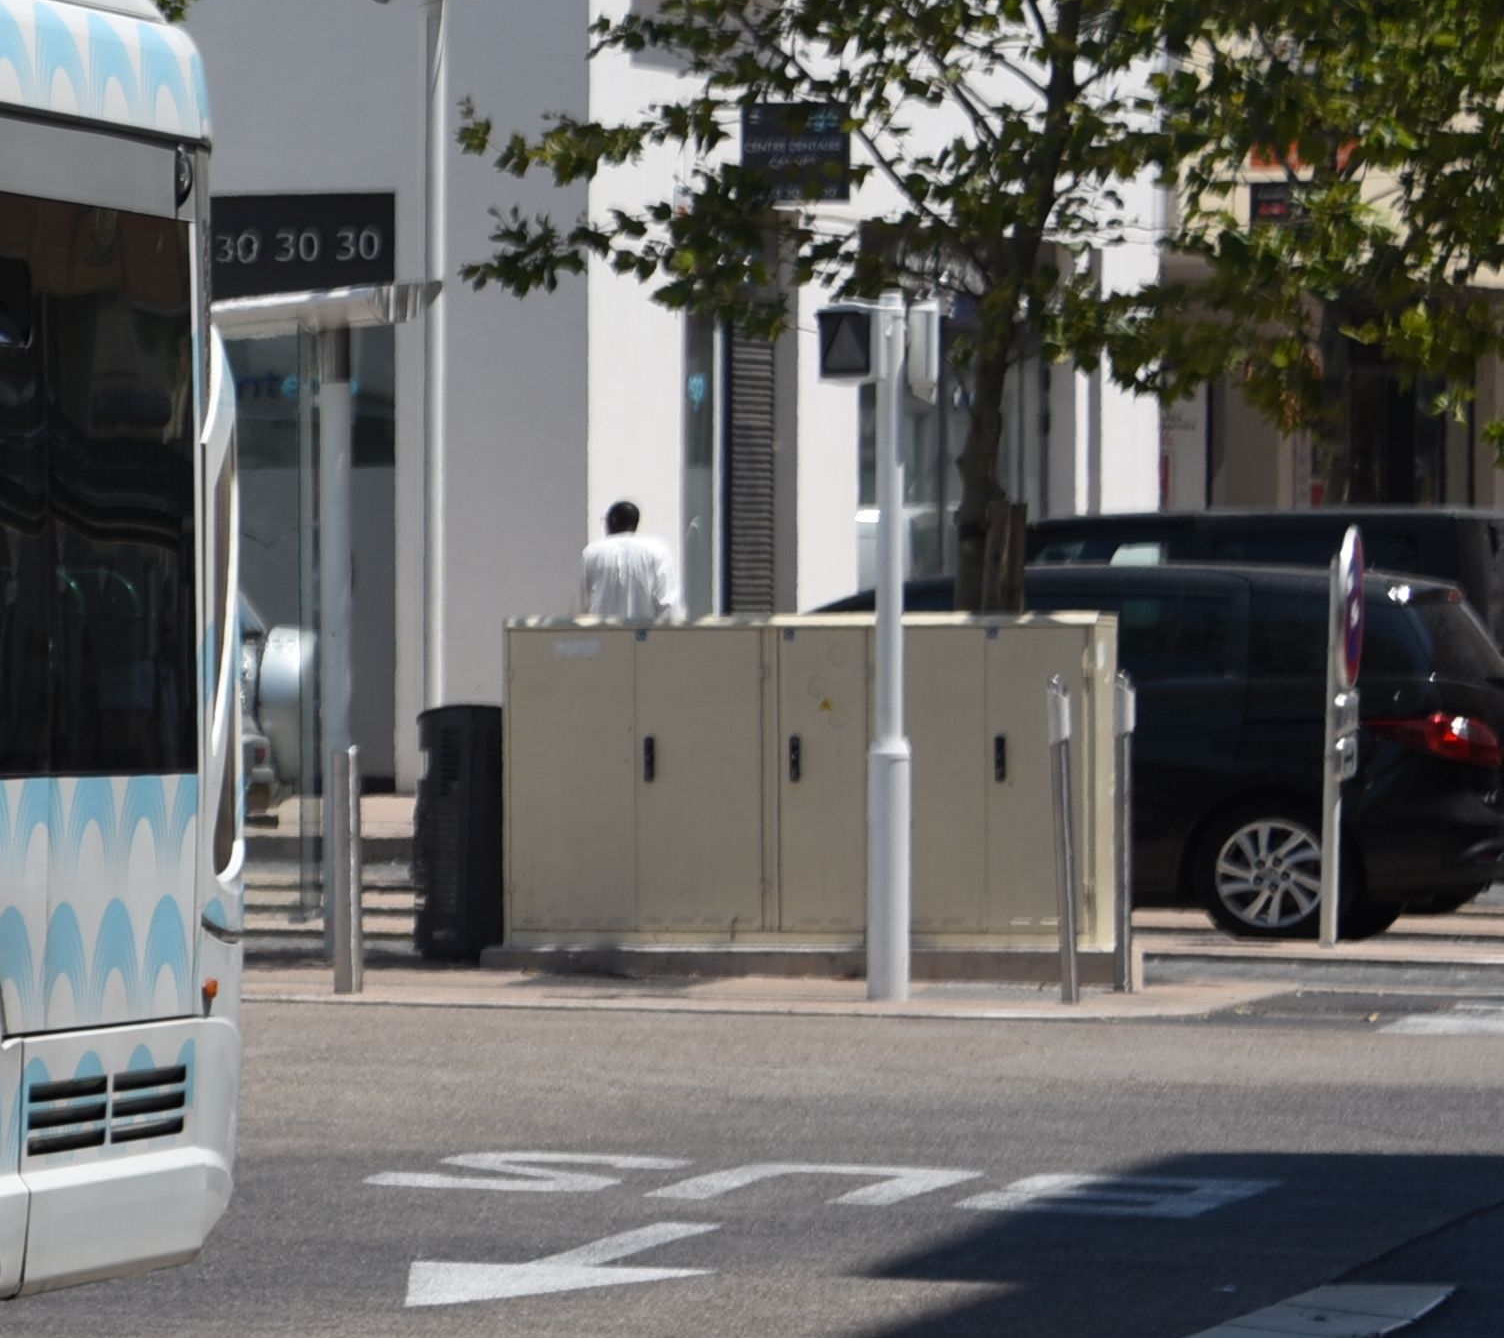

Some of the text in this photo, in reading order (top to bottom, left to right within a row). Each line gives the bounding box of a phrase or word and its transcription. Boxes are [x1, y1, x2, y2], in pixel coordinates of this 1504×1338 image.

[216, 231, 379, 264] 30 30 30
